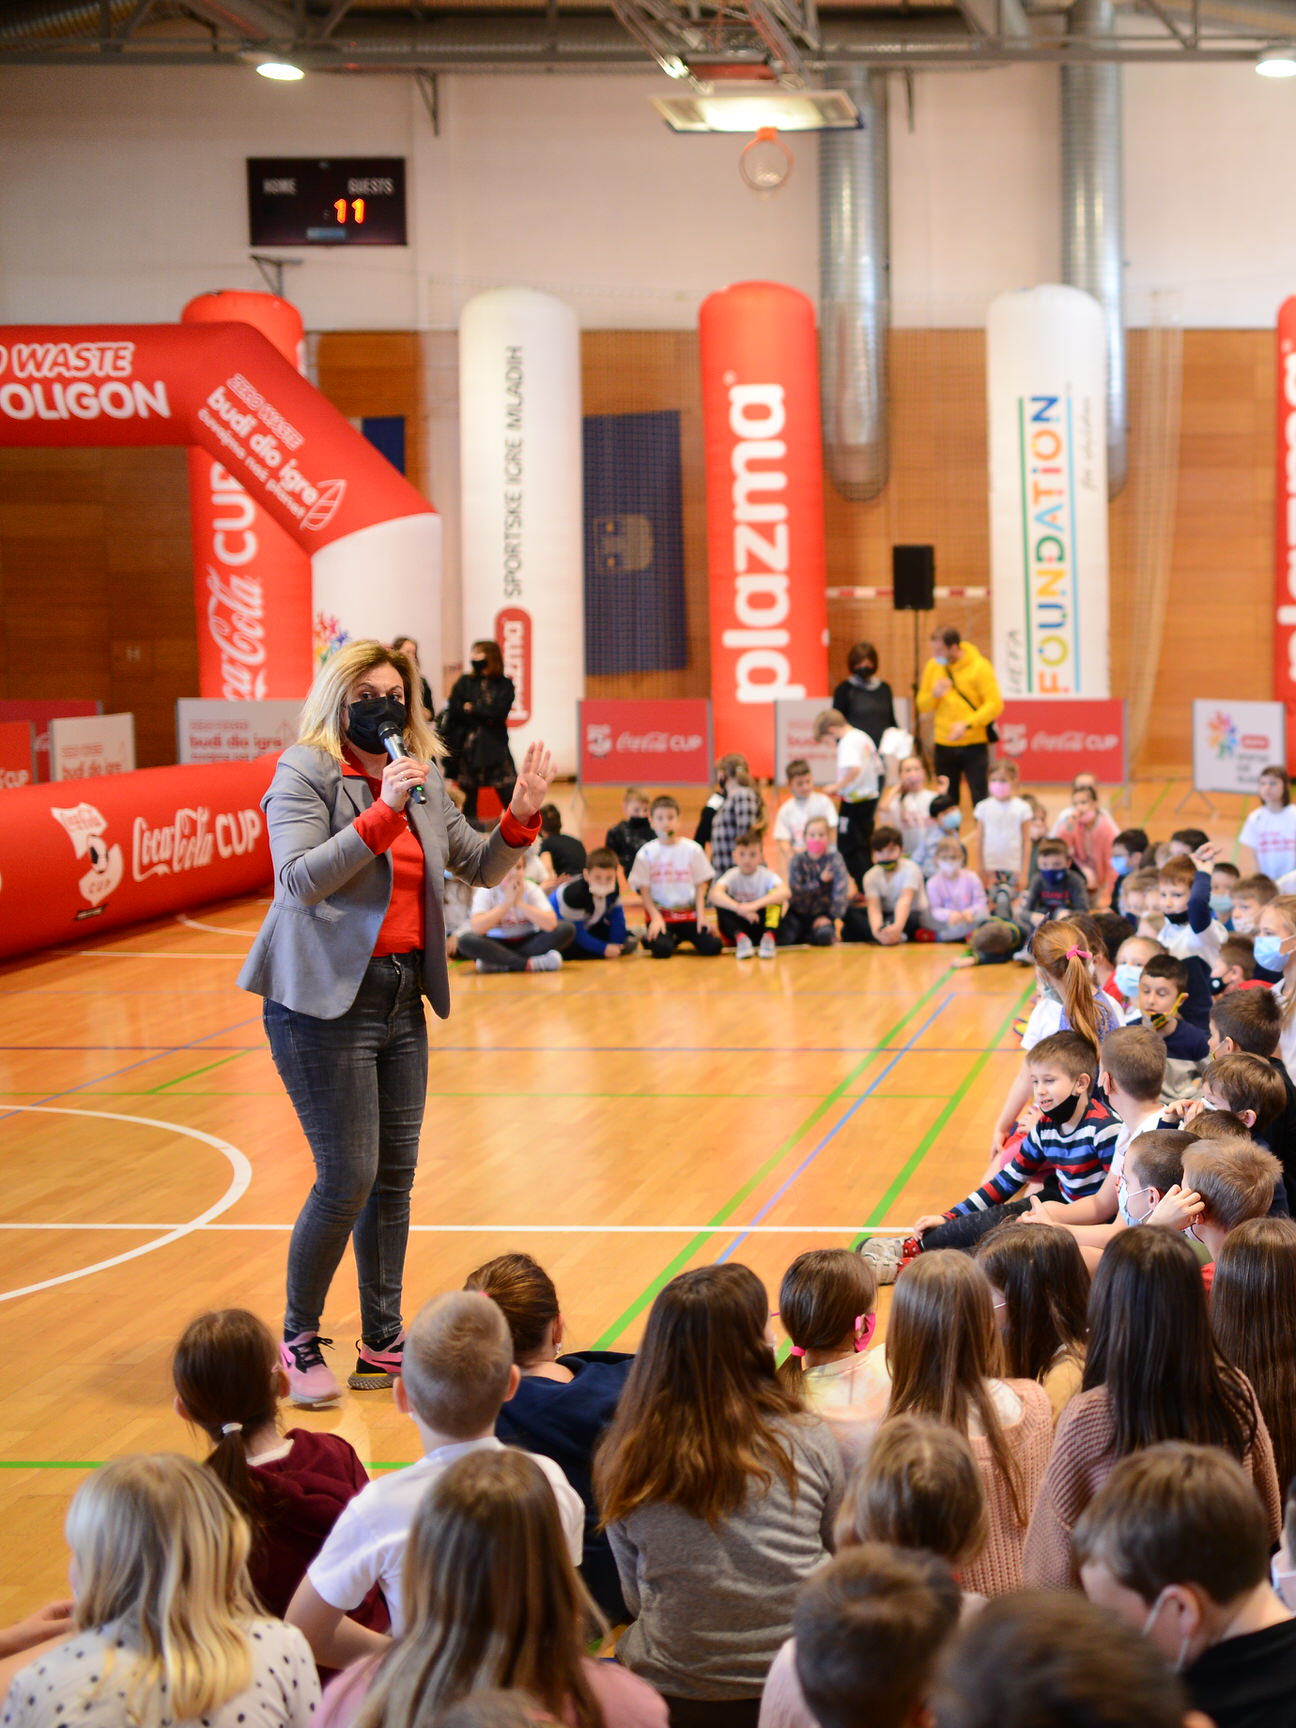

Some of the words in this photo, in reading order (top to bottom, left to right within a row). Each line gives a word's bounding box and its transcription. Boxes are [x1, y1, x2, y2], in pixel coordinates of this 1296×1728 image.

[348, 178, 394, 195] GUESTS
[334, 198, 365, 224] 11
[11, 342, 135, 379] WASTE
[0, 380, 171, 420] OLIGON
[503, 345, 522, 432] MLADIH
[207, 385, 257, 438] budi
[250, 433, 282, 468] dio
[278, 458, 318, 506] igre
[503, 437, 522, 486] IGRE
[210, 462, 258, 567] CUP
[503, 491, 522, 599] SPORTSKE
[722, 383, 806, 703] plazma
[1030, 395, 1070, 694] FOUNDATION
[670, 734, 703, 751] CUP
[1085, 733, 1119, 751] CUP
[215, 810, 261, 858] CUP
